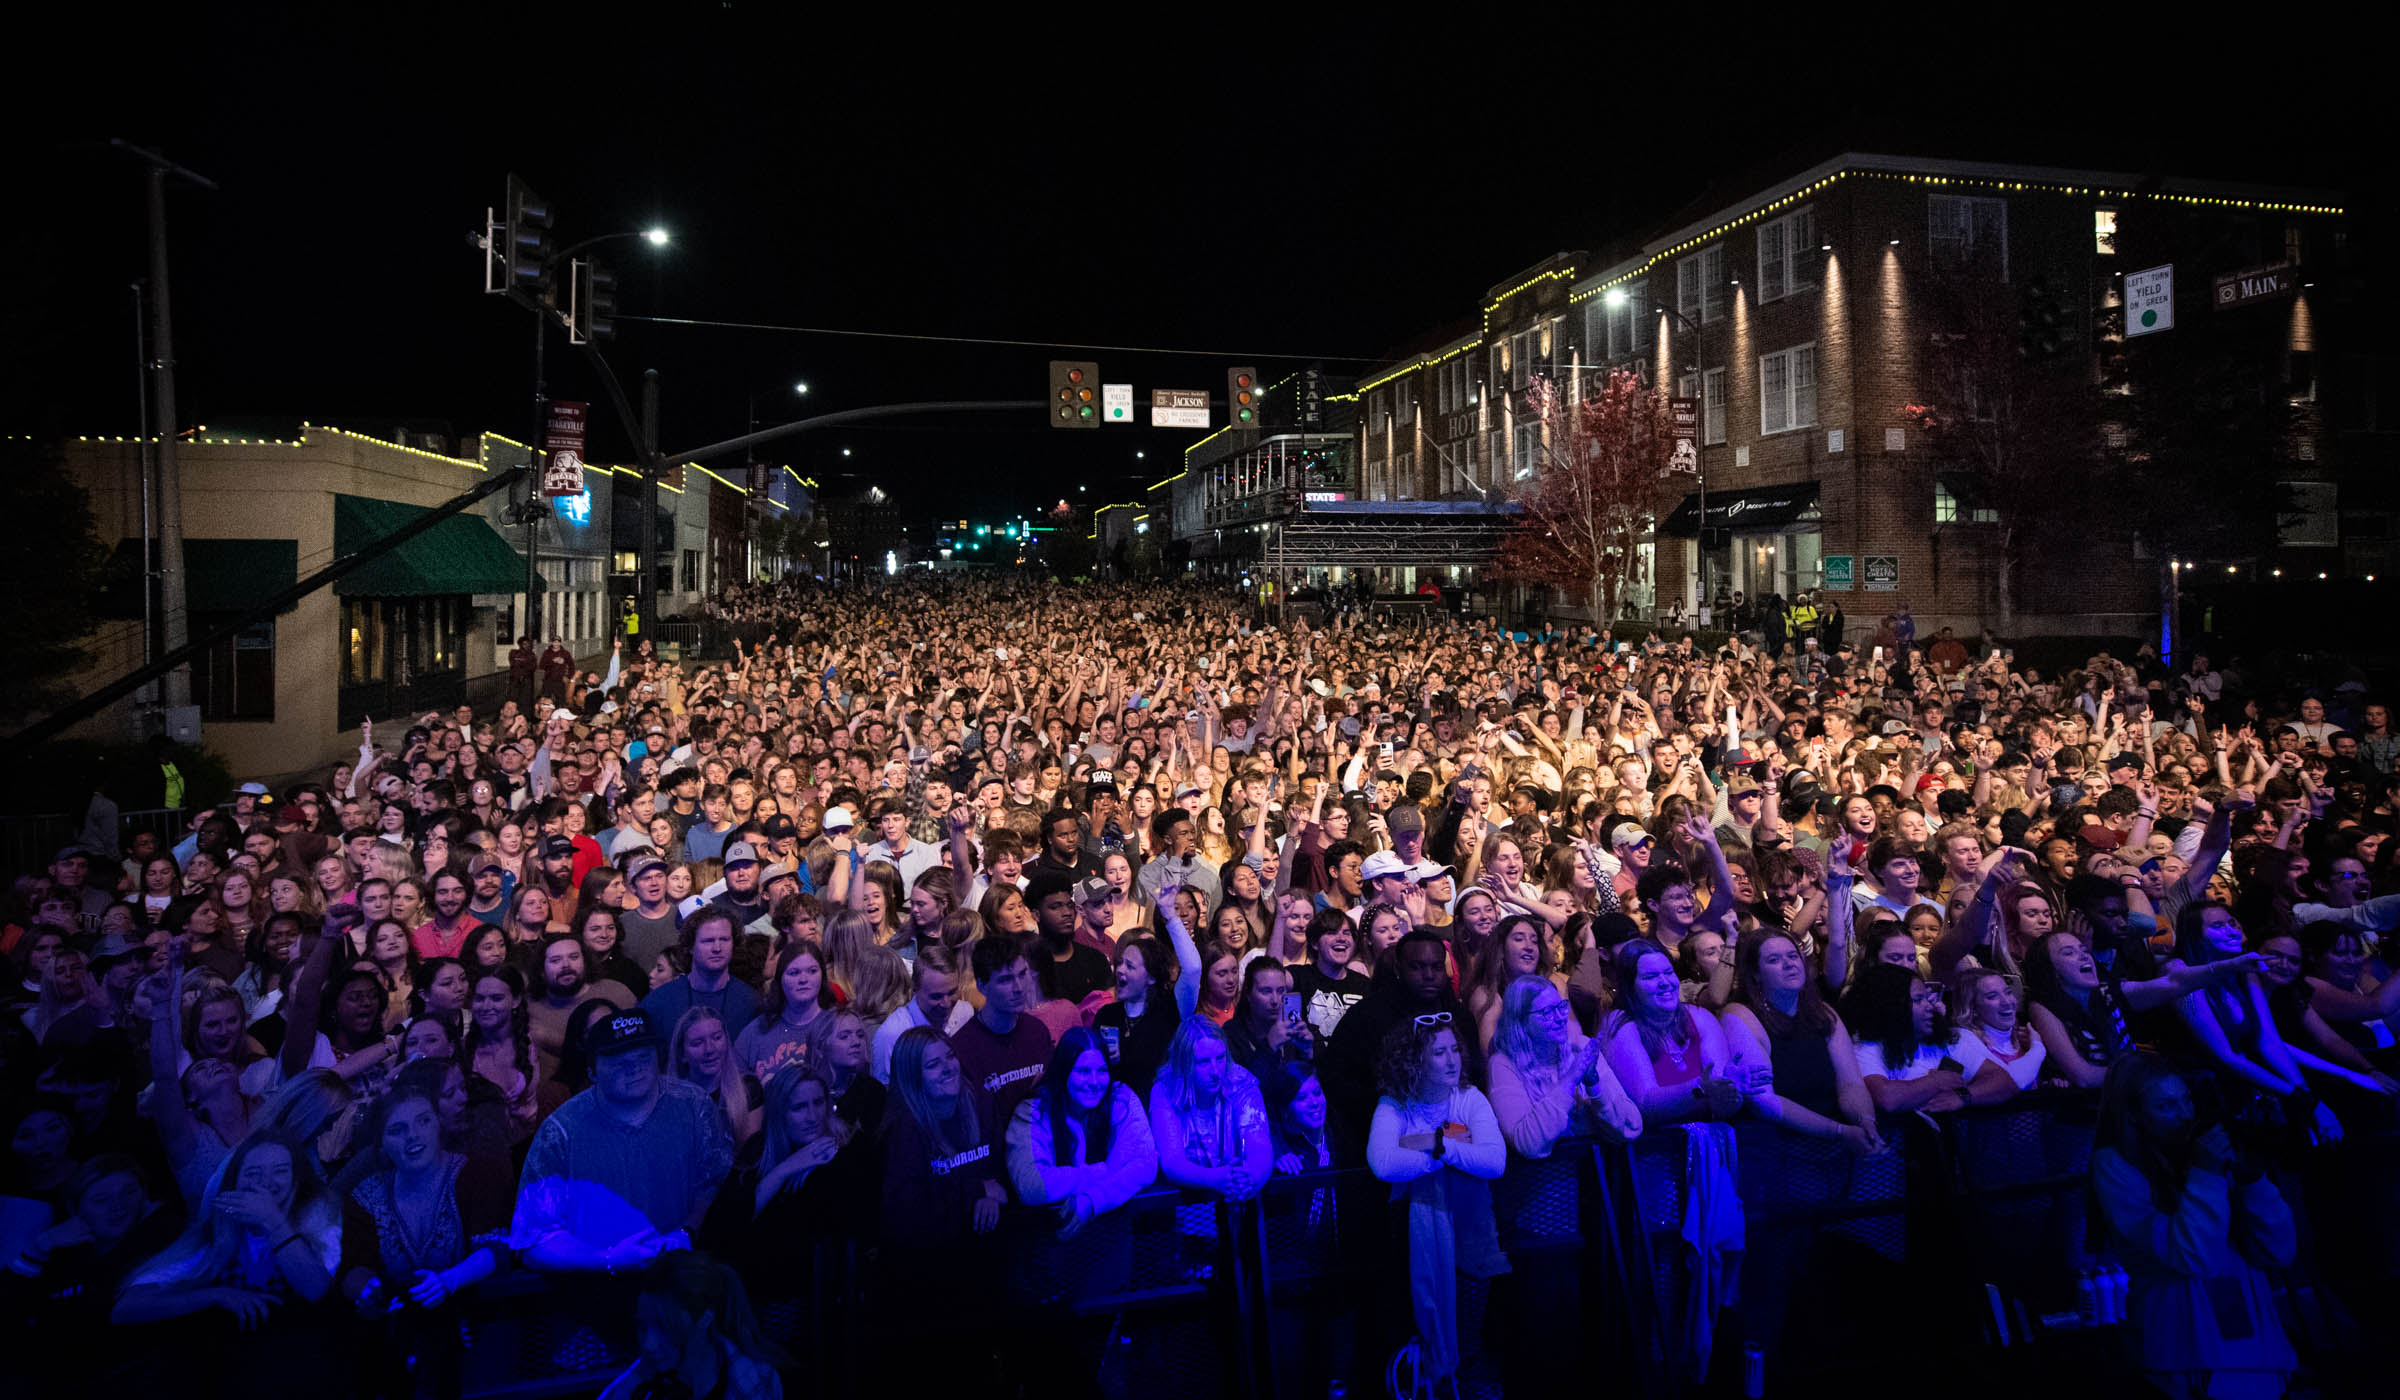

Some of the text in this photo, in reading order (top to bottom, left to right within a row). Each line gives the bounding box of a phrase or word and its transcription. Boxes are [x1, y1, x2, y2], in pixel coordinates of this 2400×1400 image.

[2127, 271, 2169, 289] LEFT TURN
[2241, 275, 2277, 299] MAIN
[2136, 284, 2161, 298] YIELD
[2130, 295, 2168, 310] ON GREEN
[1172, 395, 1204, 408] JACKSON
[1306, 369, 1320, 421] STATE
[1305, 492, 1336, 502] STATE
[1092, 770, 1112, 778] STATE
[612, 1016, 644, 1030] Coors
